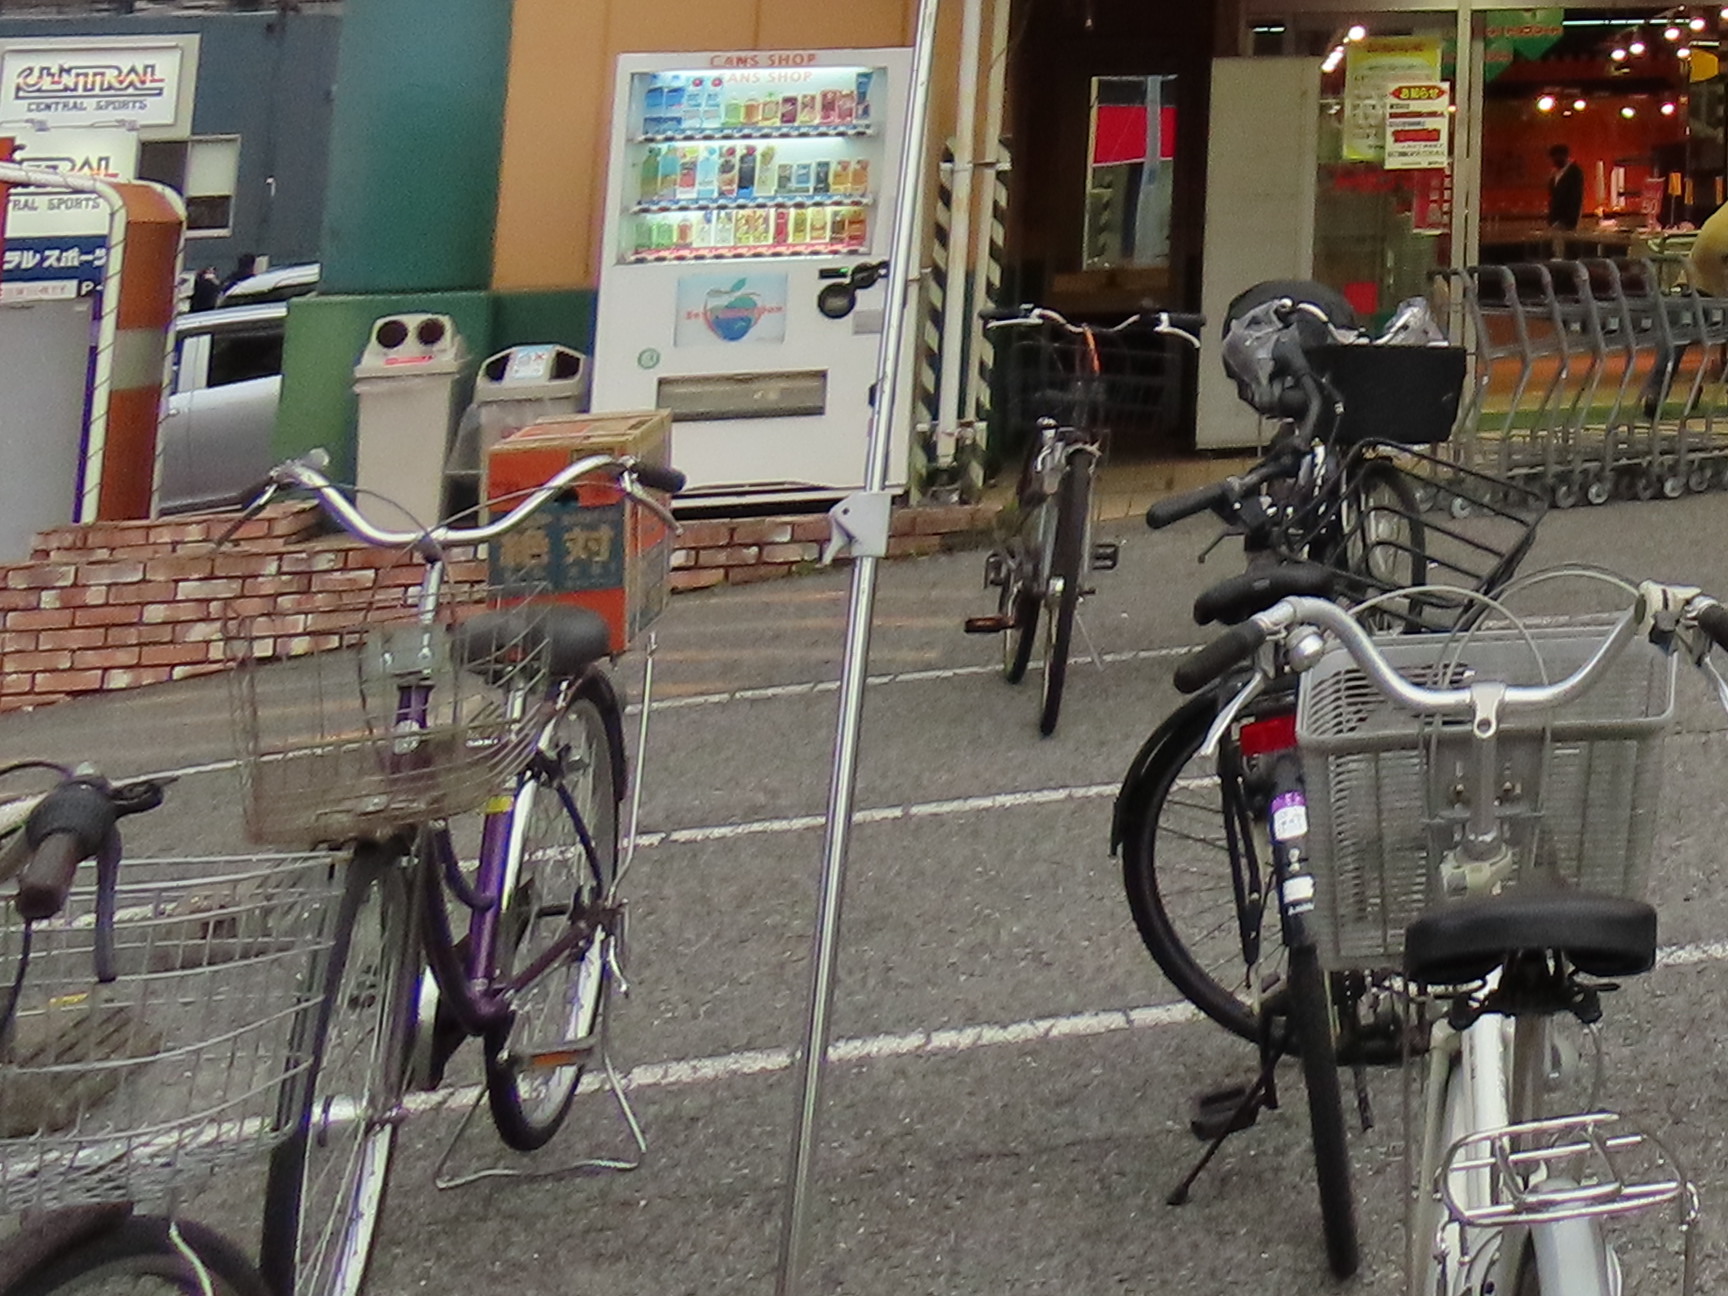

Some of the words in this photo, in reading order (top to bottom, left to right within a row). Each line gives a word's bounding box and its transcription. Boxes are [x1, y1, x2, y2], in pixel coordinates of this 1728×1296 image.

[709, 53, 760, 67] CANS
[766, 52, 818, 65] SHOP
[14, 63, 166, 100] CENTRAL
[27, 99, 87, 113] CENTRAL
[94, 98, 148, 111] SPORTS
[48, 197, 101, 210] SPORTS
